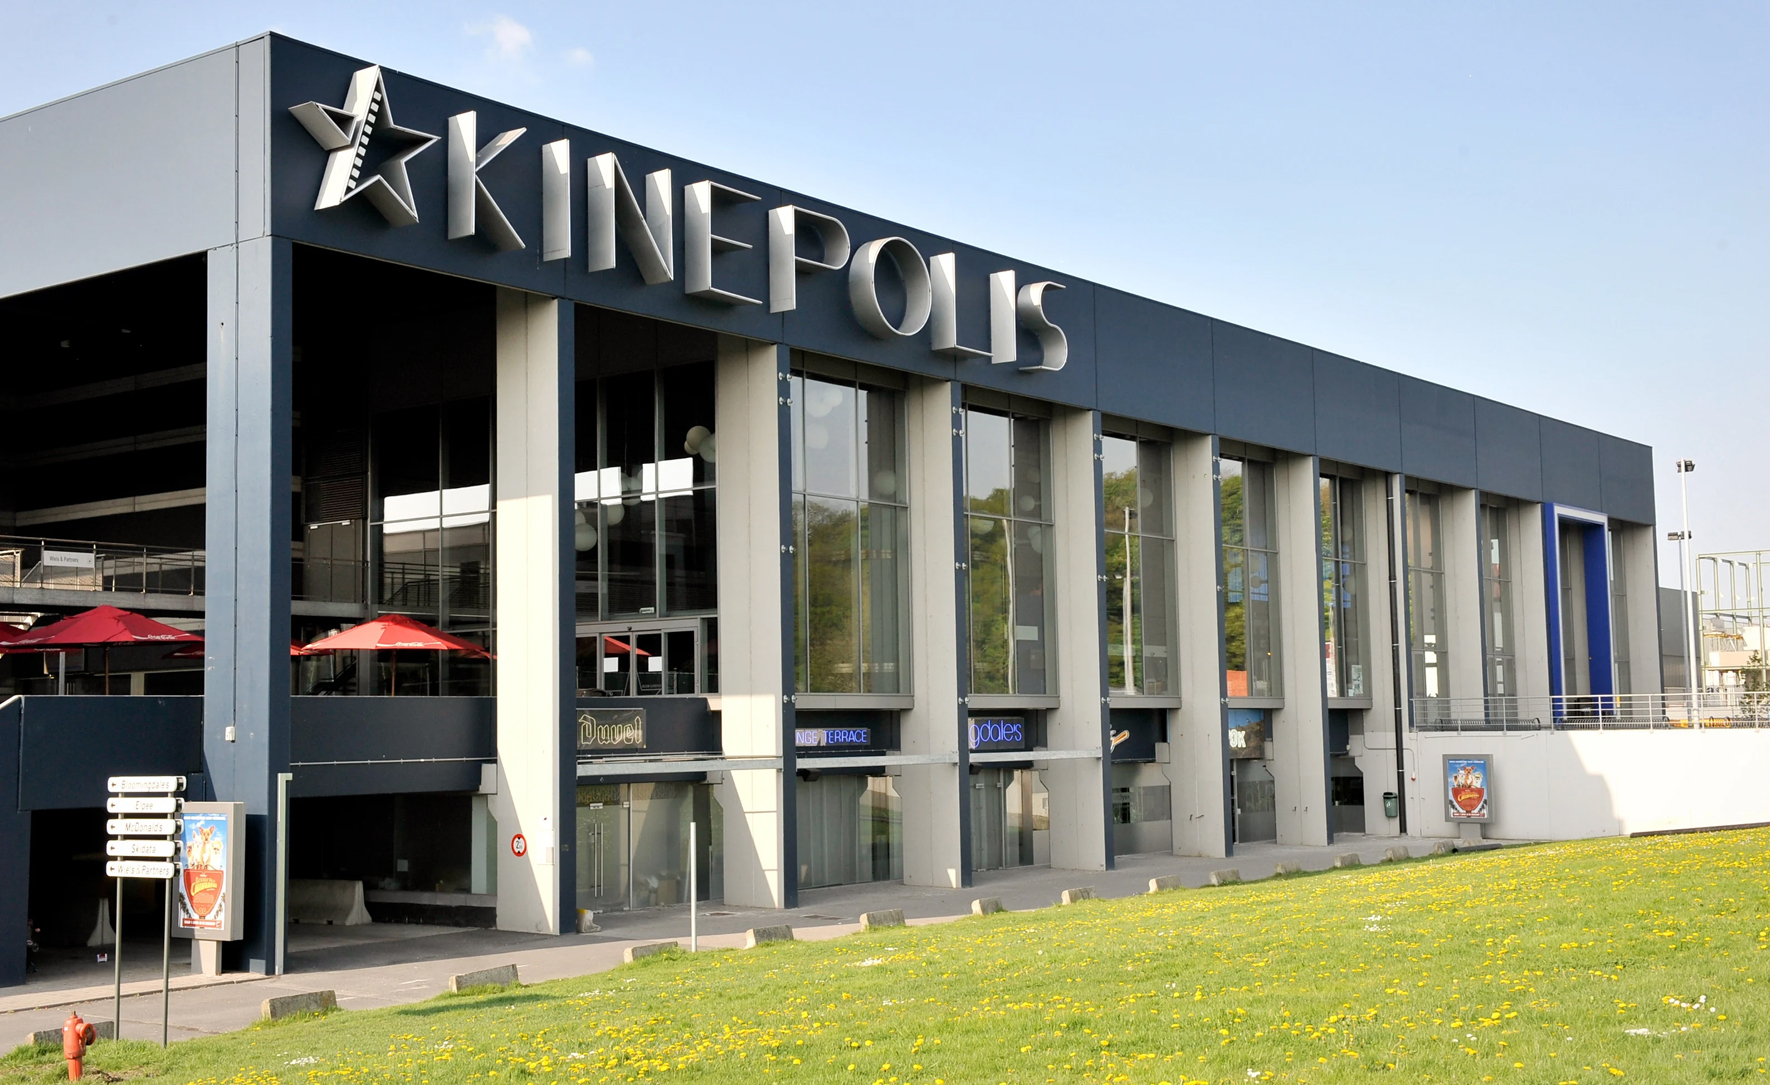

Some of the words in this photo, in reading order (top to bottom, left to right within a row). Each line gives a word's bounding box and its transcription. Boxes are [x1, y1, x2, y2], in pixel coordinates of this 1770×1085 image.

[447, 110, 1068, 372] KINEPOLIS
[578, 714, 642, 745] Duvel
[822, 729, 868, 744] TERRACE
[131, 843, 156, 854] Skidata
[141, 864, 170, 876] Partners
